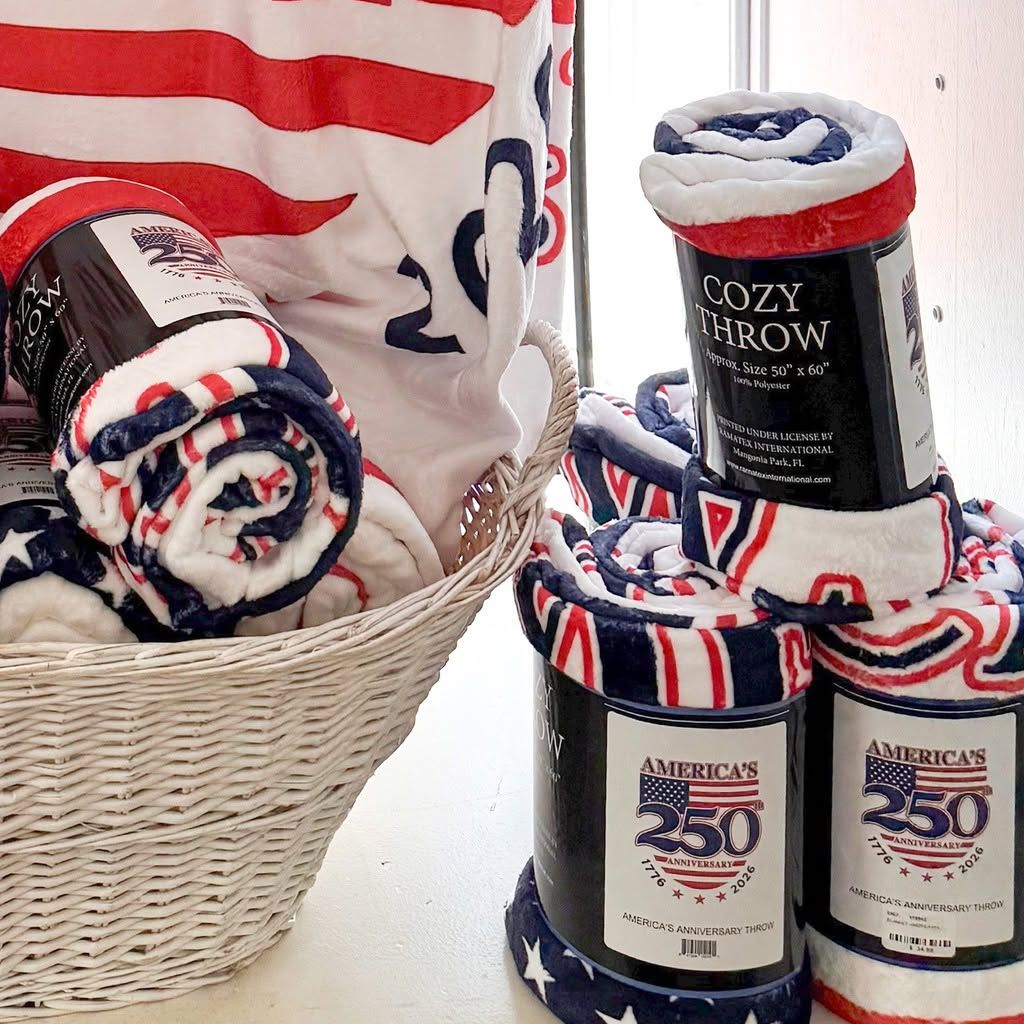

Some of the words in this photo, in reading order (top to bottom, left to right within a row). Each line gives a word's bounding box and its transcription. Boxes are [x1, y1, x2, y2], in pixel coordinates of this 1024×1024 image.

[703, 275, 804, 312] COZY
[696, 303, 831, 352] THROW
[706, 347, 741, 372] Approx.
[743, 361, 767, 376] Size
[797, 367, 805, 376] x
[733, 376, 752, 386] 100%
[754, 380, 790, 391] Polyester
[717, 414, 745, 433] PRINTED
[746, 428, 778, 440] UNDER
[780, 432, 820, 441] LICENSE
[821, 432, 833, 440] BY
[718, 427, 753, 449] RAMATEX
[754, 441, 834, 454] INTERNATIONAL
[733, 446, 768, 464] Mangonia
[866, 738, 986, 766] AMERICA'S
[640, 756, 758, 780] AMERICA'S
[861, 783, 990, 840] 250
[635, 801, 762, 859] 250
[894, 837, 961, 849] ANNIVERSARY
[667, 859, 733, 868] ANNIVERSARY
[868, 836, 893, 865] 1776
[958, 846, 984, 873] 2026
[641, 859, 666, 887] 1776
[730, 865, 755, 893] 2026
[848, 885, 901, 906] AMERICA'S
[904, 901, 971, 913] ANNIVERSARY
[973, 900, 1004, 911] THROW
[622, 912, 674, 933] AMERICA'S
[676, 925, 742, 936] ANNIVERSARY
[745, 921, 775, 934] THROW
